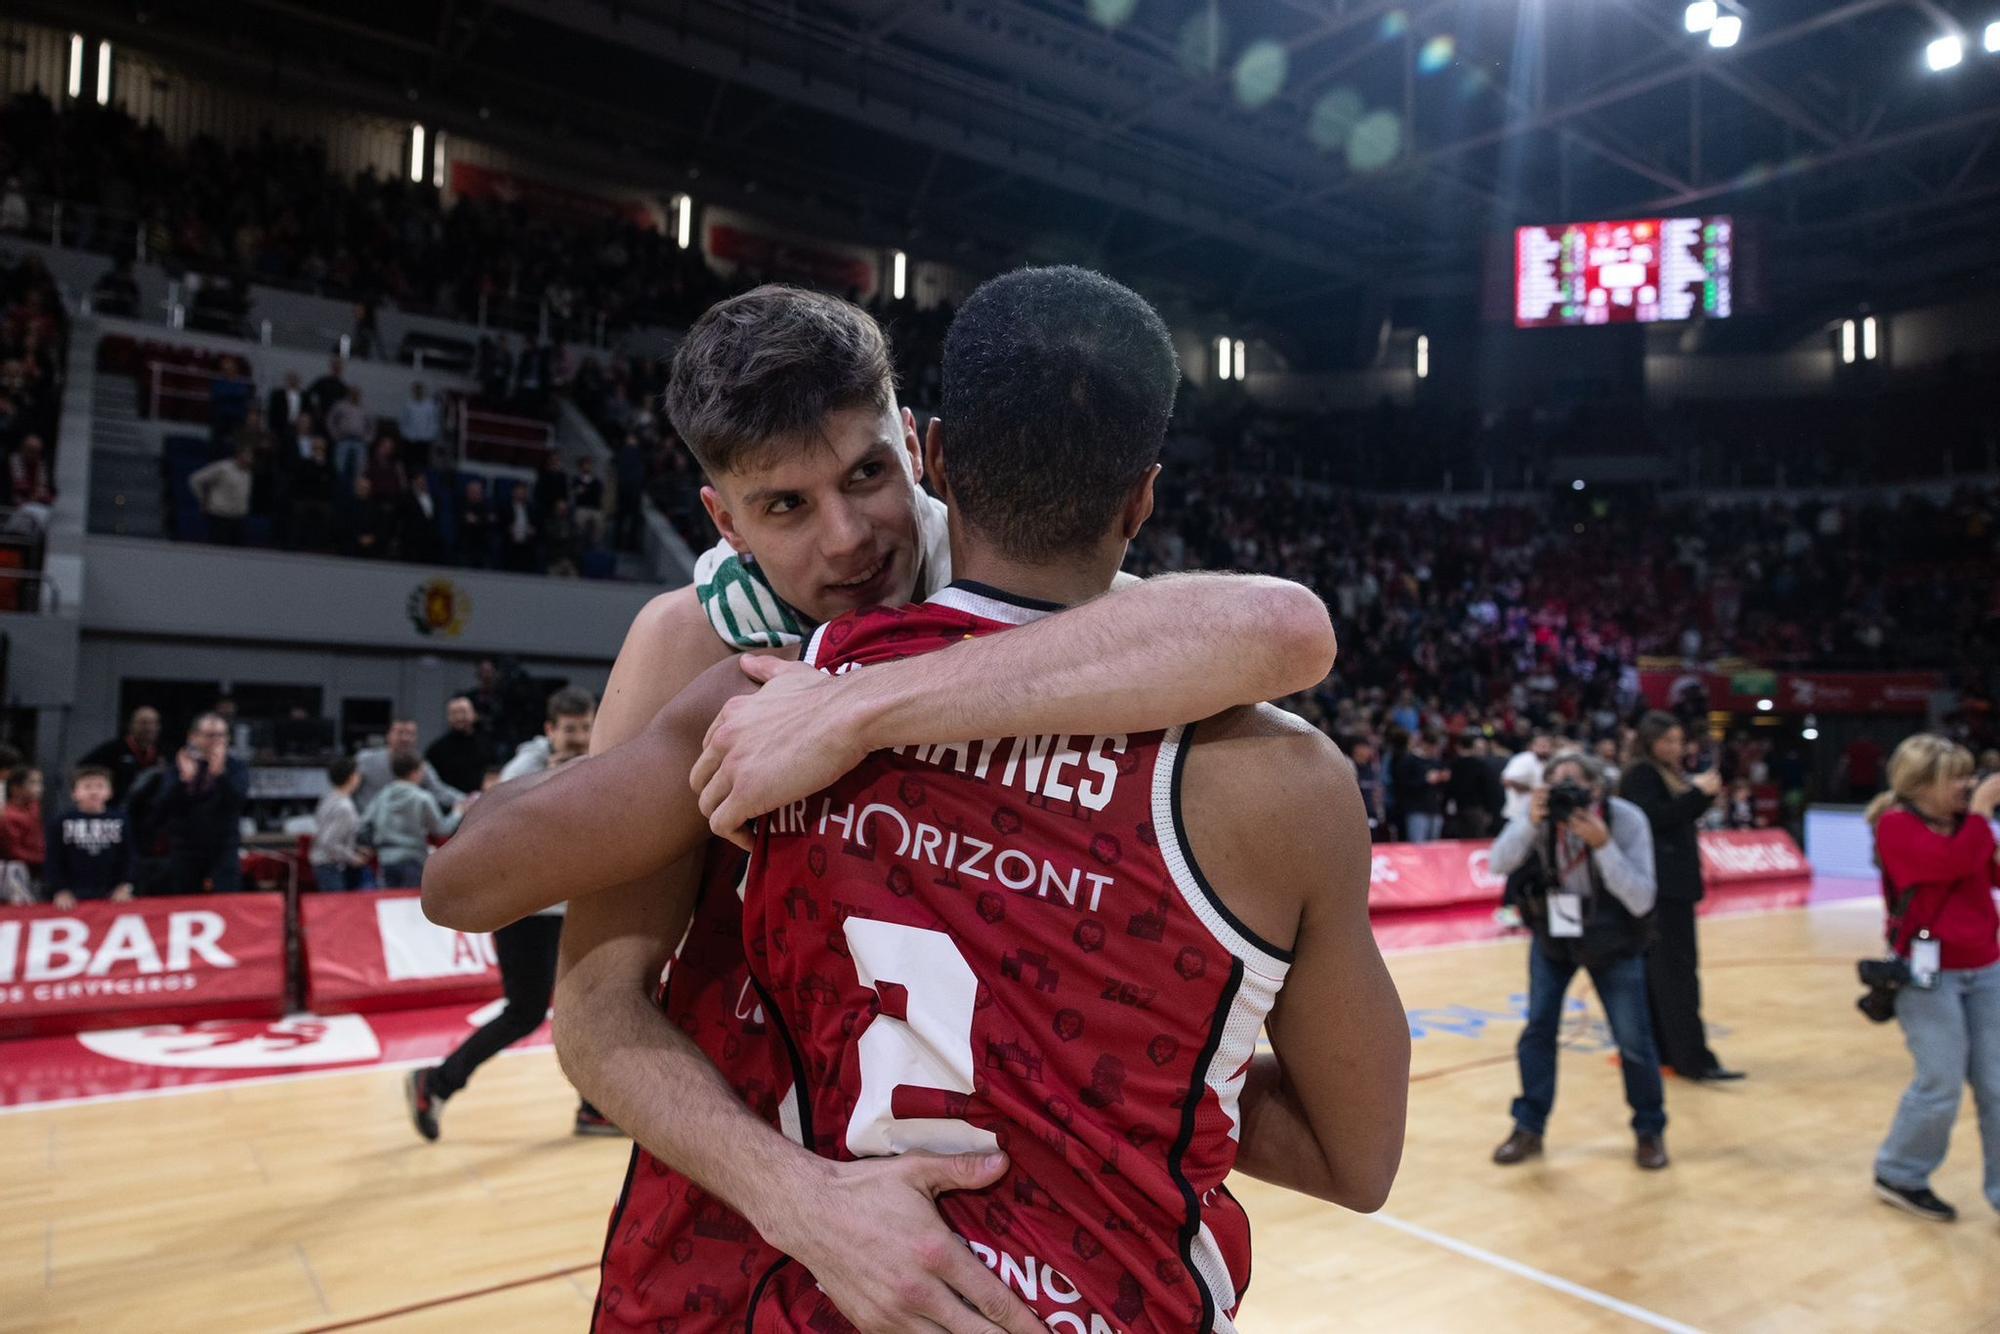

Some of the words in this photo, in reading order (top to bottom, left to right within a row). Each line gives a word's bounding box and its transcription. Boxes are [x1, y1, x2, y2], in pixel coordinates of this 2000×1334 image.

[893, 733, 1129, 812] YNES
[818, 797, 1114, 912] HORIZONT
[0, 910, 238, 984] BAR
[33, 973, 197, 1001] CERVECEROS
[846, 915, 999, 1158] 2
